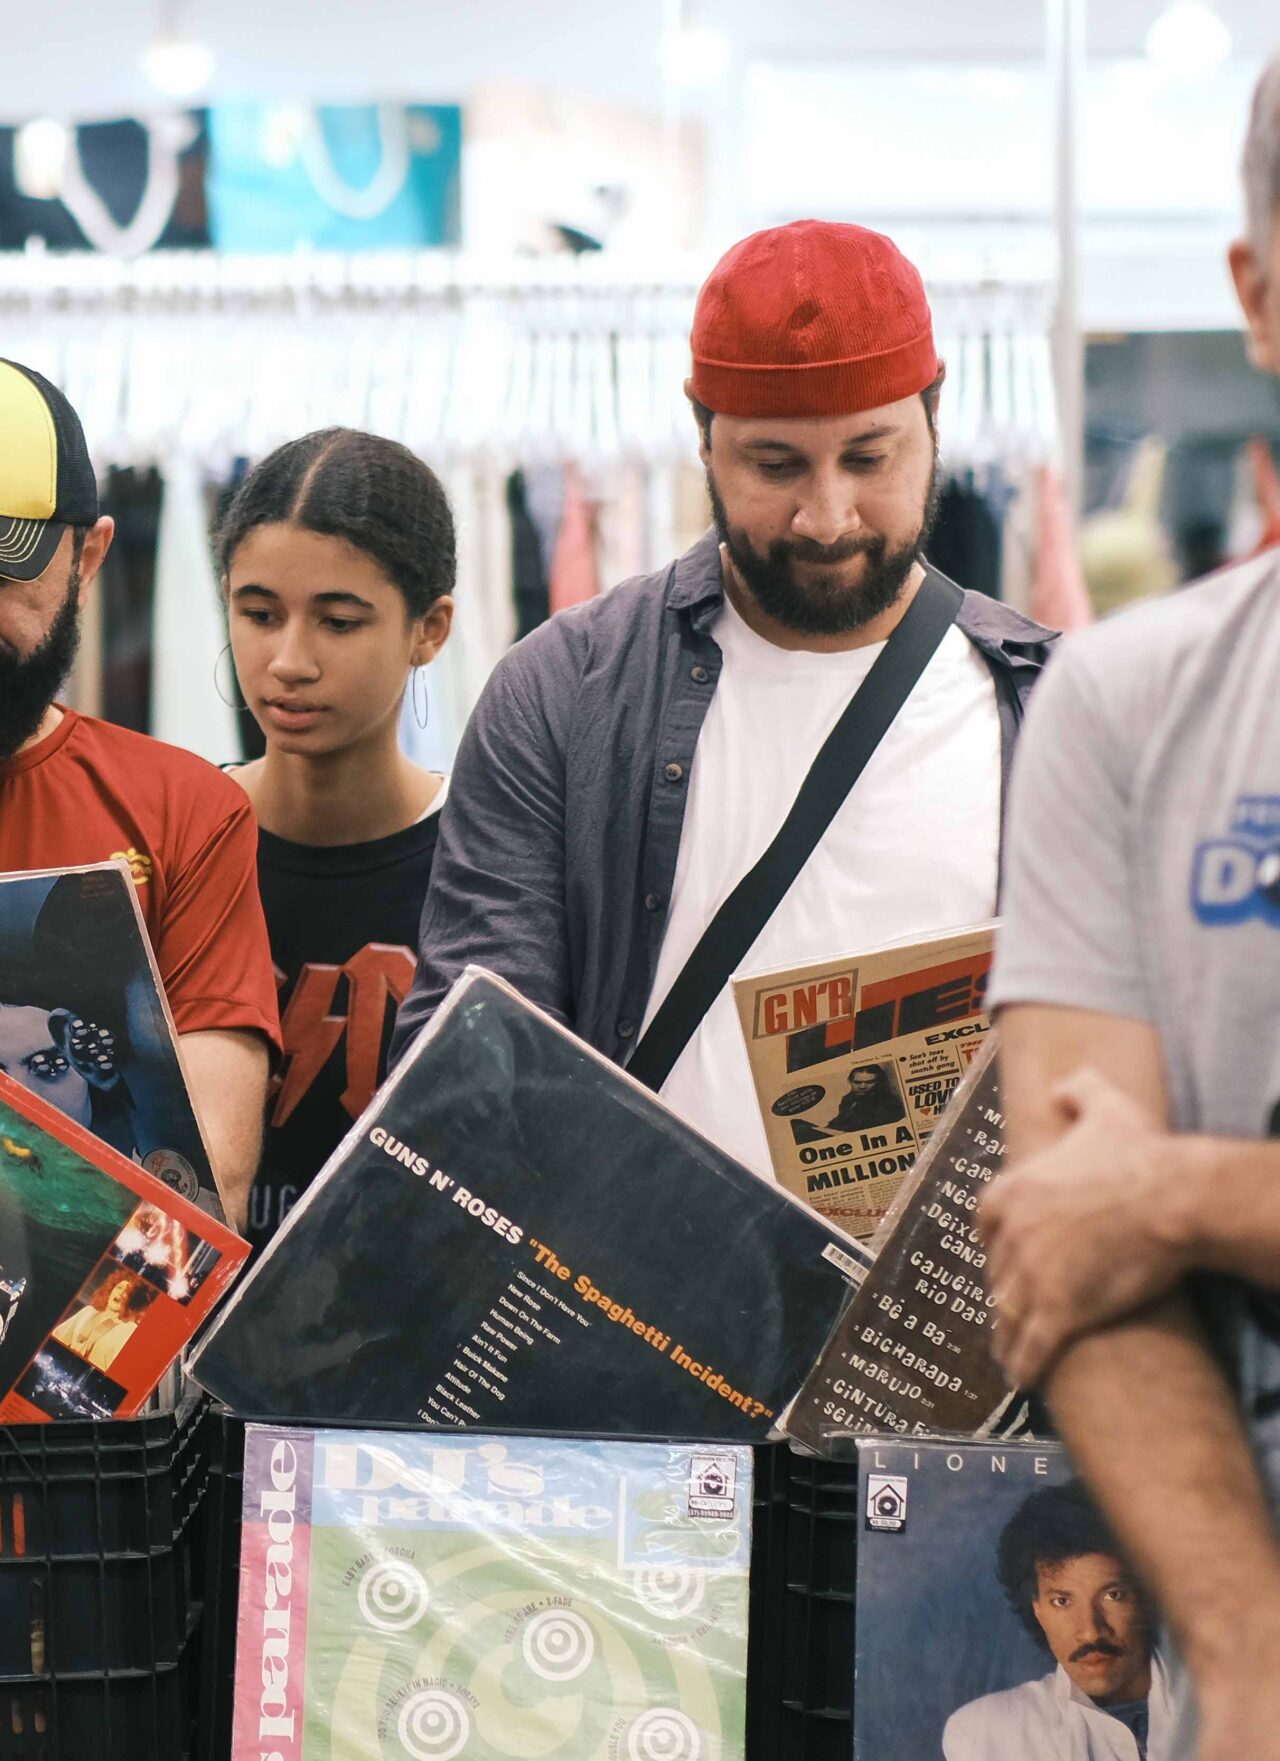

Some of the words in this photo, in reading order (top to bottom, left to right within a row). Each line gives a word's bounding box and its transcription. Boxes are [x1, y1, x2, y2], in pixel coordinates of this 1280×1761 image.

[764, 977, 851, 1035] GN'R
[925, 1024, 990, 1046] EXCL
[907, 1080, 942, 1096] USED
[944, 1076, 960, 1087] TO
[800, 1143, 852, 1164] One
[860, 1134, 887, 1151] In
[896, 1126, 913, 1144] A
[807, 1153, 916, 1192] MILLION
[366, 1126, 430, 1178] GUNS
[428, 1169, 454, 1195] N'
[452, 1186, 525, 1245] ROSES
[523, 1239, 574, 1282] "The
[571, 1275, 670, 1353] Spaghetti
[668, 1344, 773, 1425] Incident?"
[507, 1283, 524, 1298] New
[522, 1294, 541, 1310] Rose
[515, 1271, 536, 1289] Since
[538, 1288, 558, 1304] Don't
[557, 1301, 576, 1317] Have
[480, 1321, 497, 1336] Raw
[495, 1332, 518, 1351] Power
[489, 1308, 514, 1329] Human
[512, 1326, 534, 1345] Being
[497, 1296, 518, 1314] Down
[517, 1310, 530, 1322] On
[528, 1318, 543, 1331] The
[542, 1327, 561, 1344] Farm
[461, 1347, 482, 1364] Buick
[481, 1360, 508, 1382] Makane
[471, 1334, 488, 1349] Ain't
[487, 1345, 494, 1353] It
[493, 1349, 508, 1362] Fun
[443, 1372, 472, 1394] Attitude
[452, 1359, 468, 1373] Hair
[467, 1369, 478, 1379] Of
[476, 1376, 491, 1389] The
[489, 1386, 506, 1401] Dog
[425, 1397, 440, 1410] You
[439, 1406, 459, 1423] Can't
[435, 1384, 455, 1401] Black
[454, 1397, 481, 1419] Leather
[875, 1452, 1048, 1476] LIONE
[357, 1494, 614, 1529] parade
[258, 1439, 298, 1744] parade
[411, 1678, 420, 1689] IN
[422, 1677, 448, 1687] MAGIC
